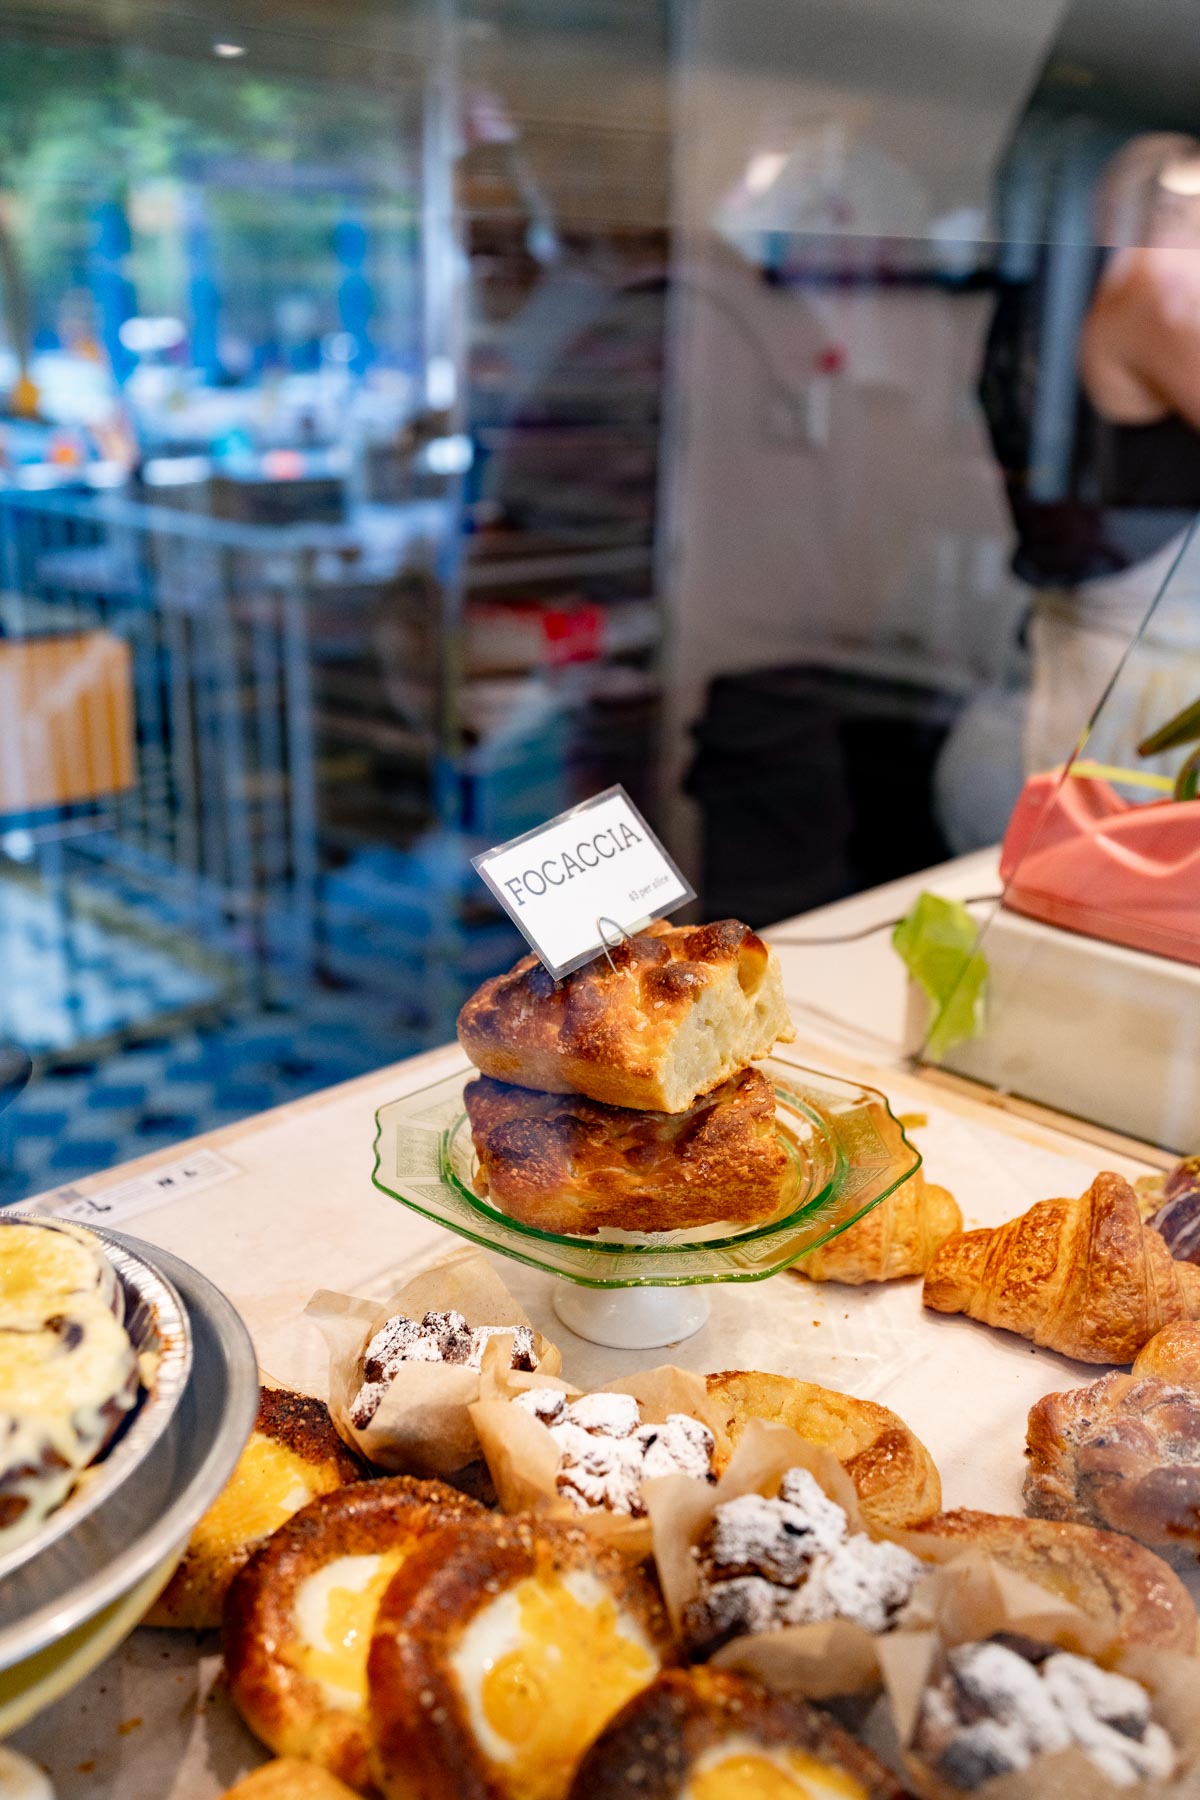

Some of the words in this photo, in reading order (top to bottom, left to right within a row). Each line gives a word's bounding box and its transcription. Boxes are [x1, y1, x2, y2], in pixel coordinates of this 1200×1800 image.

[504, 822, 642, 906] FOCACCIA
[638, 884, 651, 899] per
[652, 875, 670, 889] slice
